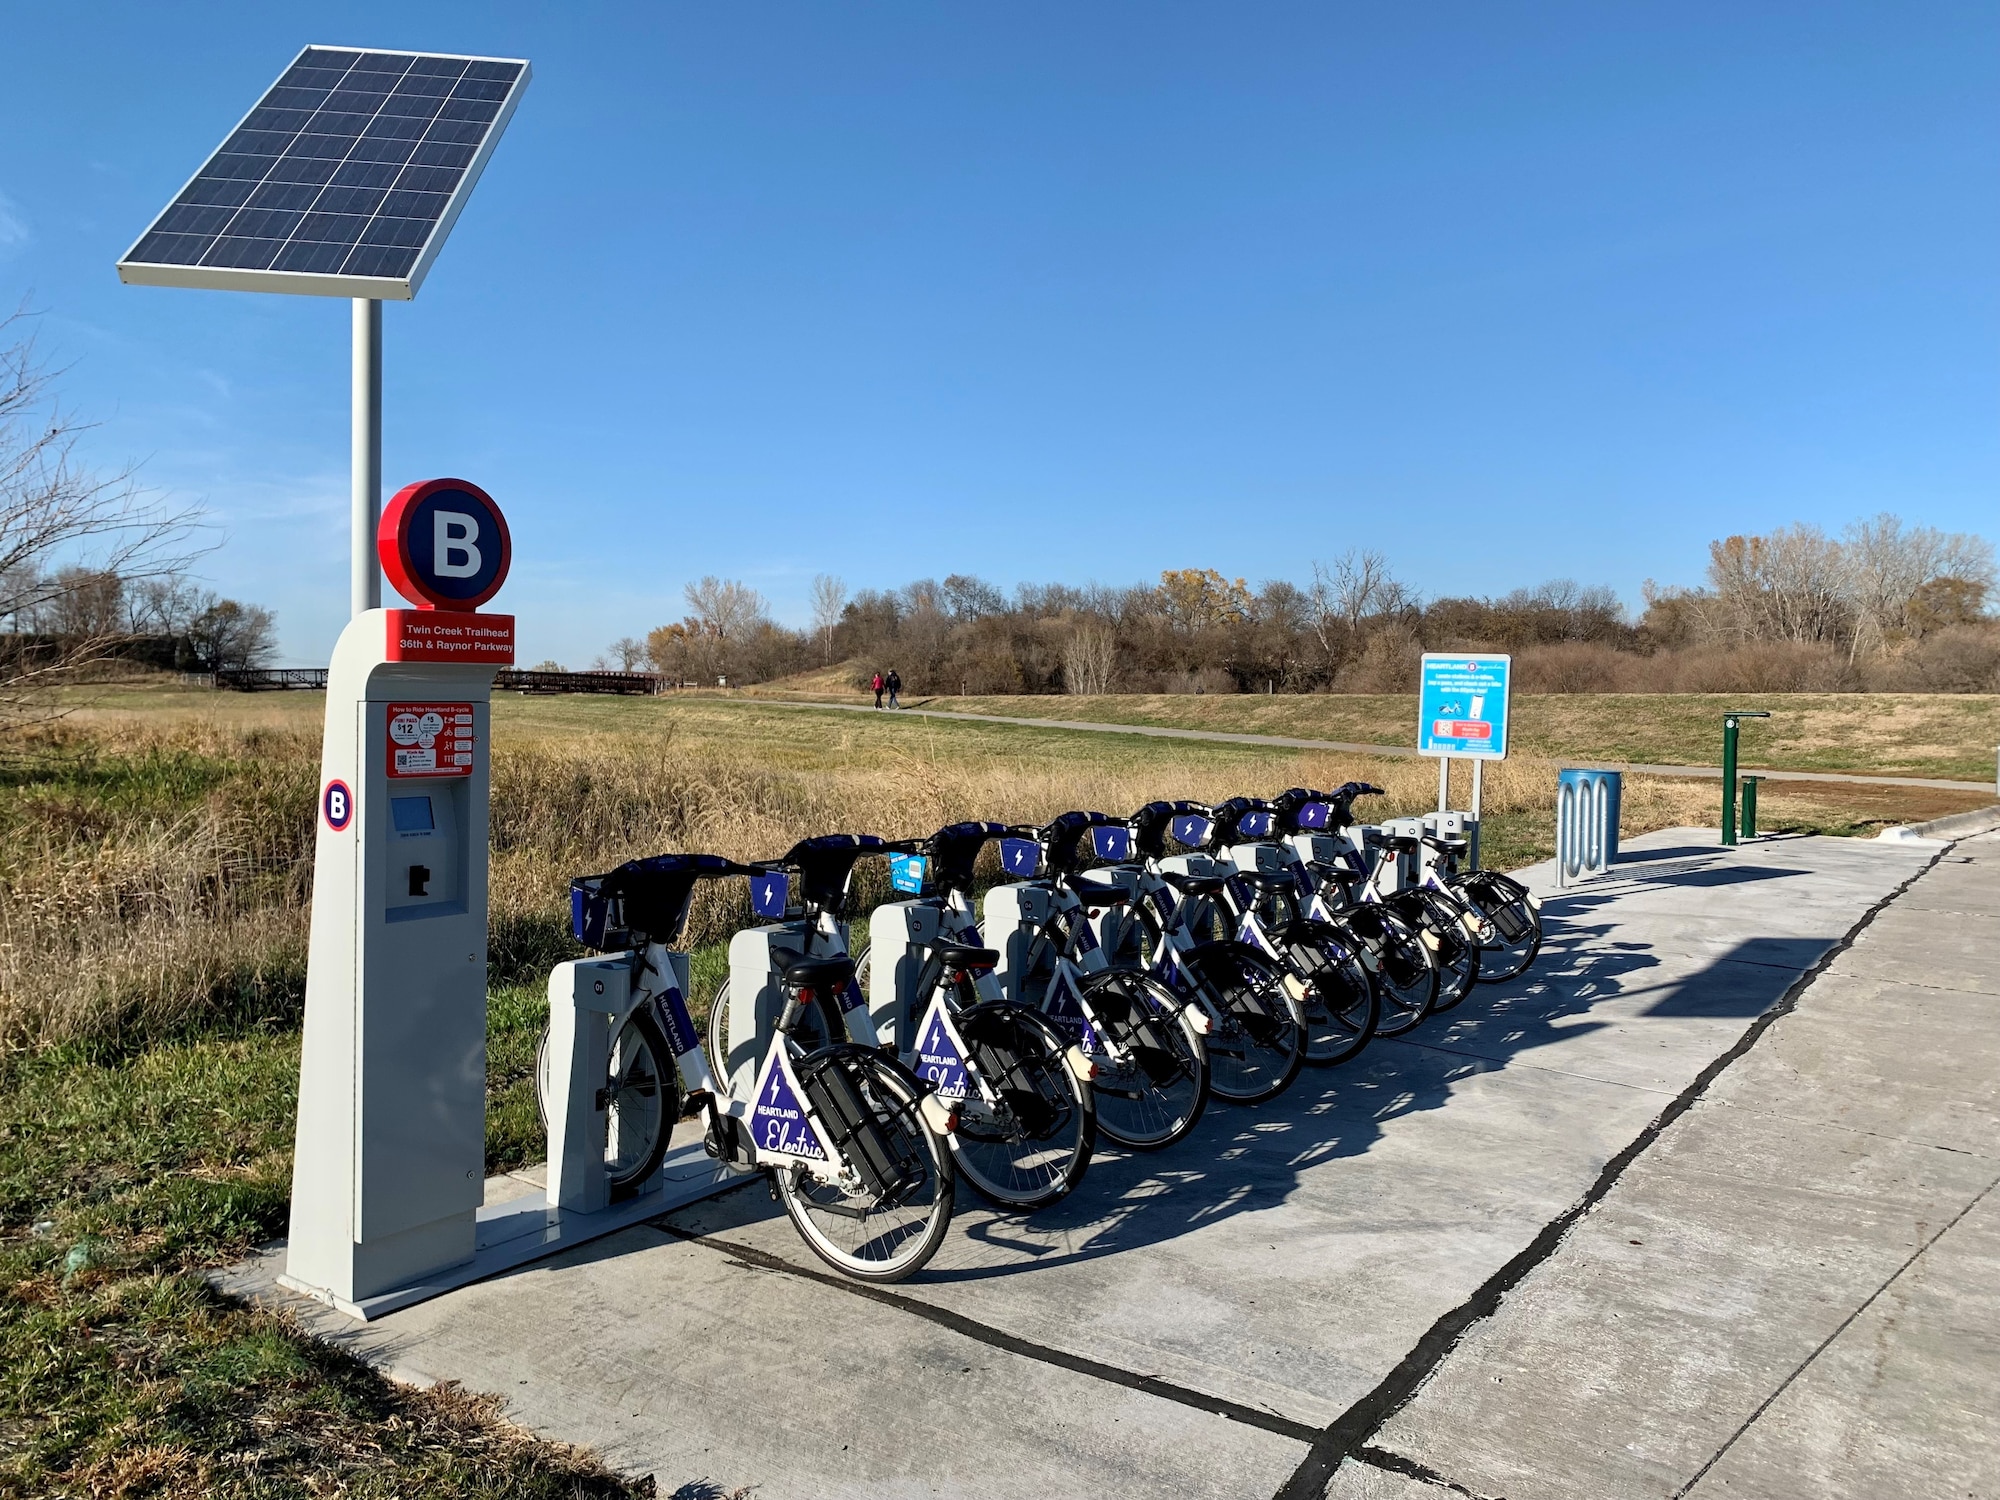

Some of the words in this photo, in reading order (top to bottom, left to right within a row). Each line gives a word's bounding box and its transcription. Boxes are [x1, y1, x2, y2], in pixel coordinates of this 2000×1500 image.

[434, 510, 482, 578] B
[406, 624, 430, 634] Twin
[434, 626, 462, 636] Creek
[464, 626, 509, 638] Trailhead
[400, 639, 423, 649] 36th
[426, 640, 434, 649] &
[436, 640, 471, 652] Raynor
[474, 642, 514, 654] Parkway
[398, 724, 413, 734] $12
[330, 790, 345, 820] B
[1155, 891, 1171, 921] HEARTLA
[595, 983, 603, 992] 01
[659, 995, 684, 1052] HEARTLAND
[920, 1054, 957, 1066] HEARTLAND
[758, 1105, 798, 1120] HEARTLAND
[766, 1119, 824, 1158] Electric
